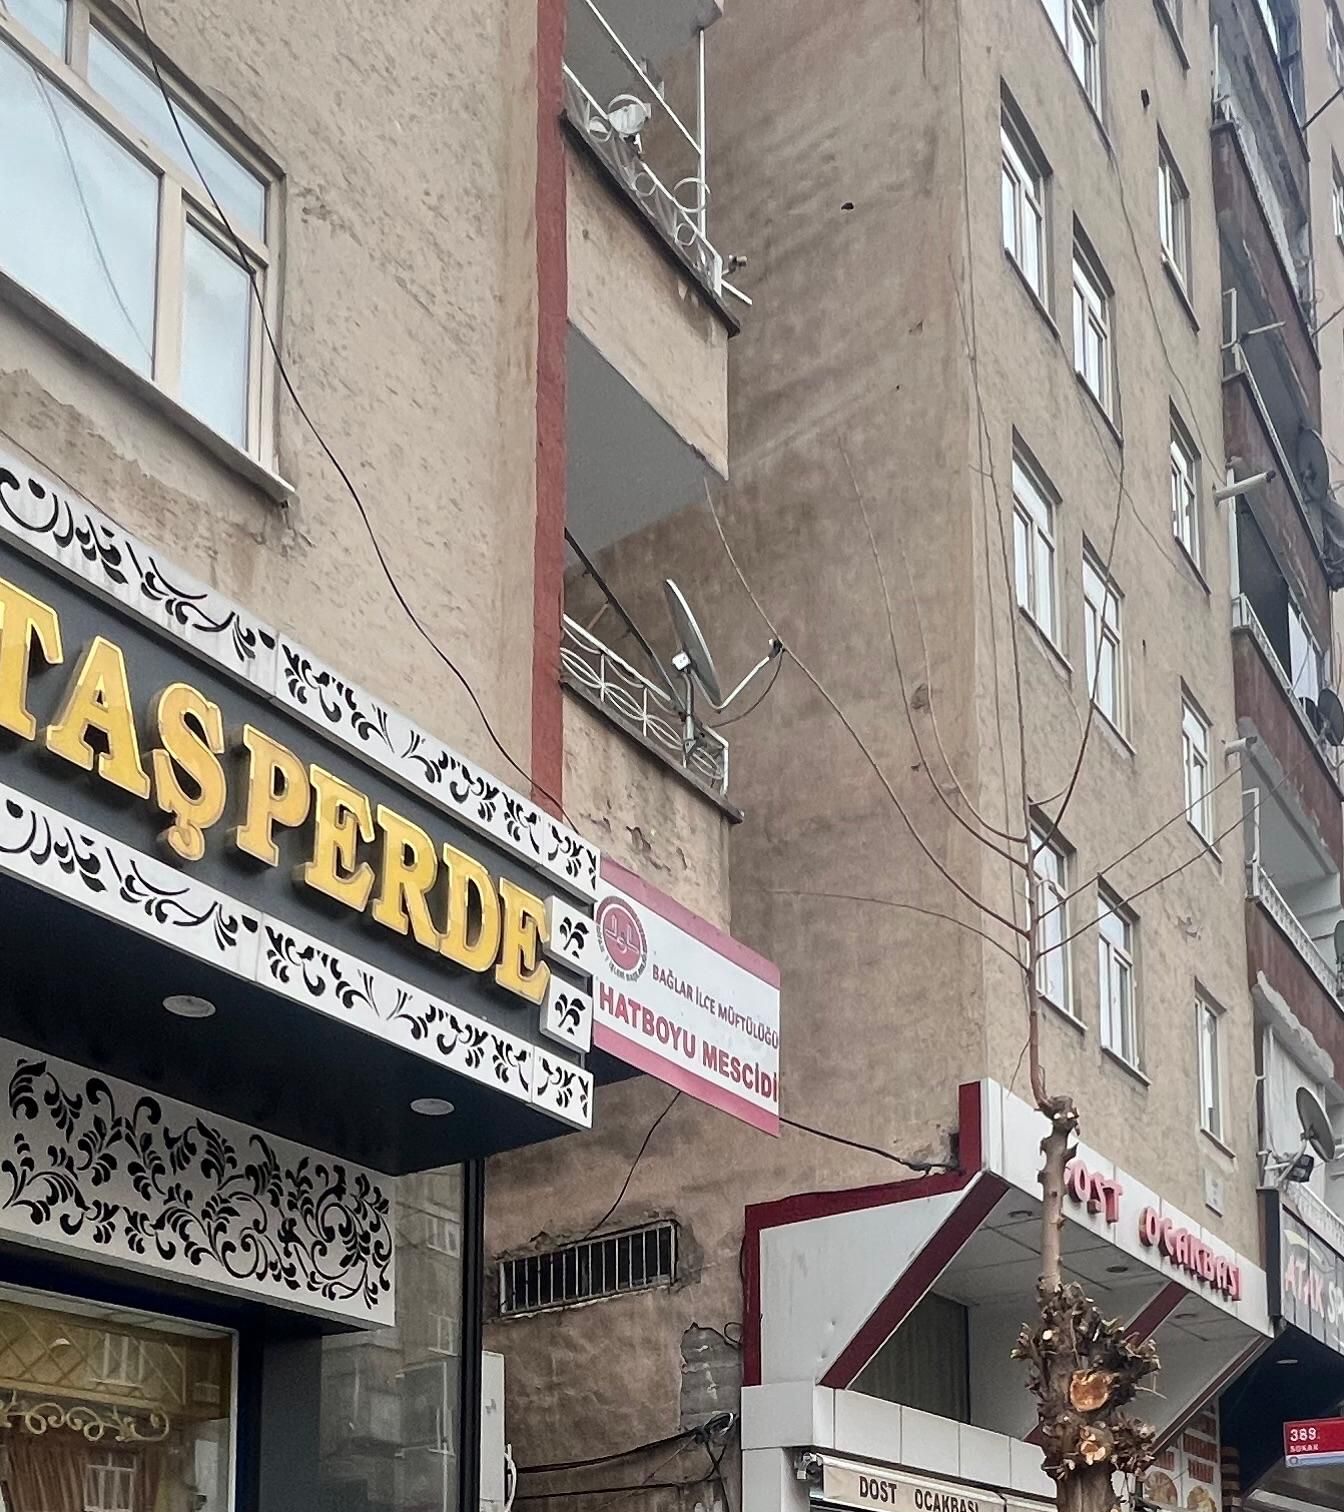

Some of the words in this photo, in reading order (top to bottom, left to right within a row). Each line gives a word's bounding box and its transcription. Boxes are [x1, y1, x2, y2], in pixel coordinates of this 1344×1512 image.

[236, 724, 552, 1004] PERDE
[652, 963, 693, 1003] BAĞLAR
[599, 981, 696, 1059] HATBOYU
[702, 1039, 777, 1103] MESCİDİ
[859, 1475, 897, 1505] DOST
